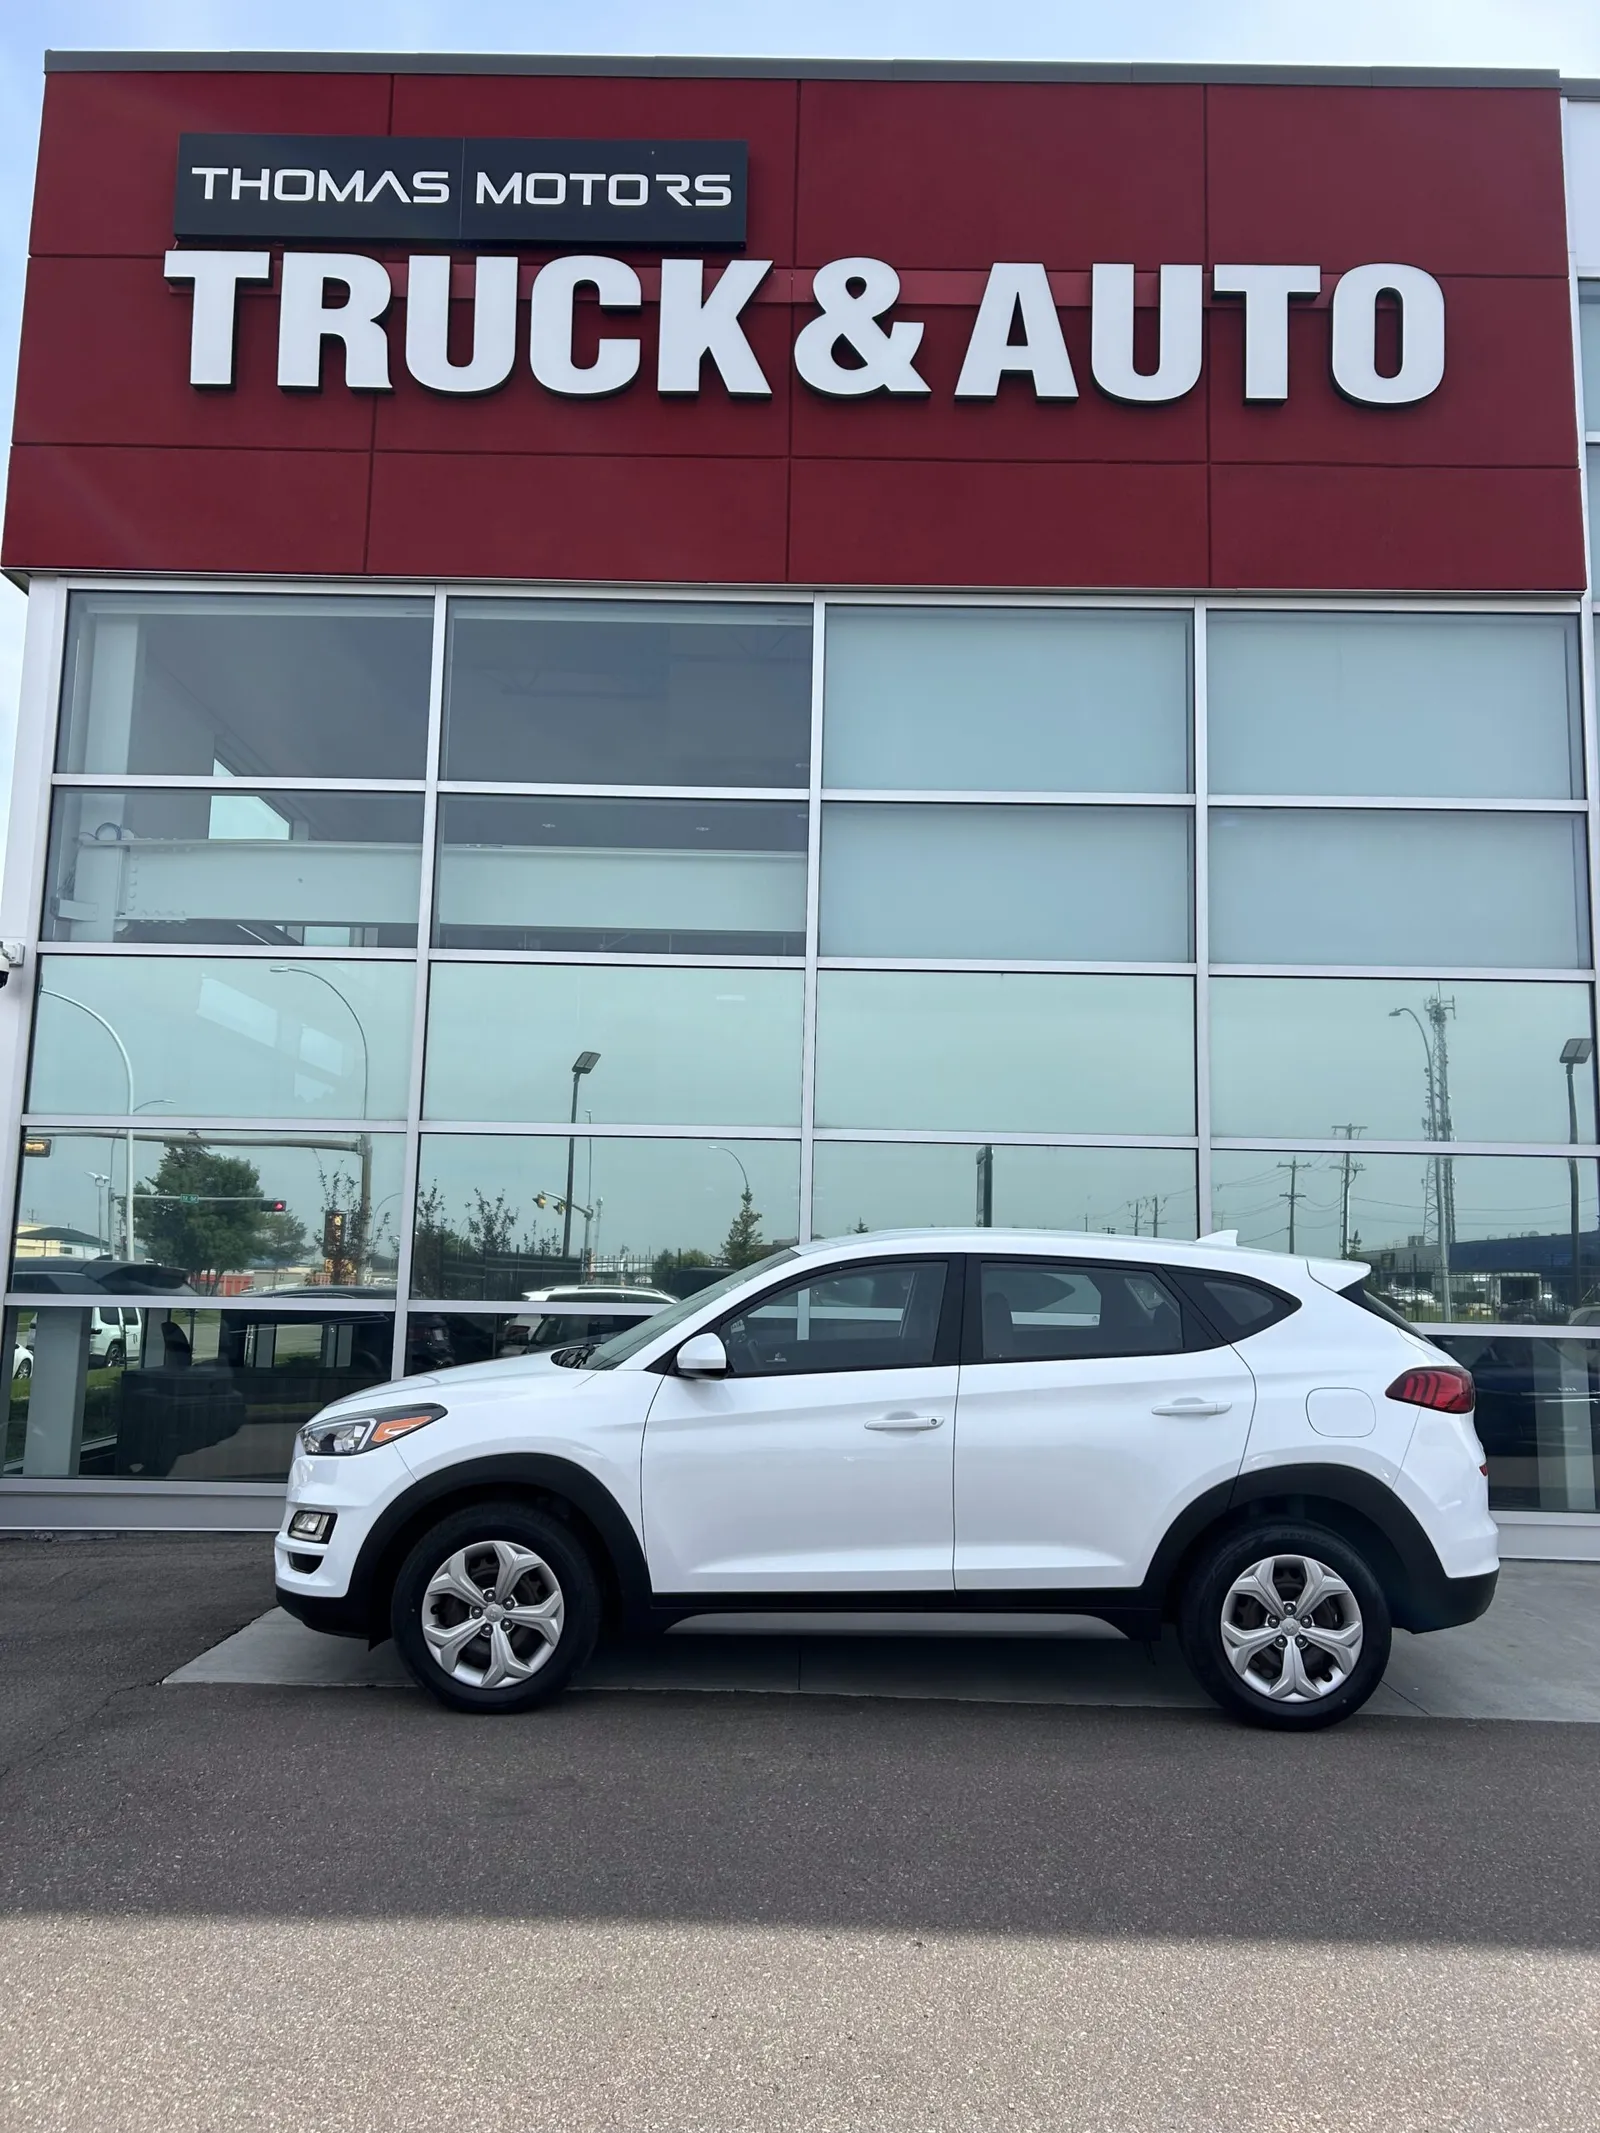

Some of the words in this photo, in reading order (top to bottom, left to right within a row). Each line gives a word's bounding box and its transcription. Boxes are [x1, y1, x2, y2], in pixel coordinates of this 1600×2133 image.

[192, 168, 449, 203] THOMAS
[476, 172, 731, 206] MOTORS
[164, 251, 773, 397] TRUCK
[794, 258, 931, 397] &
[955, 263, 1444, 406] AUTO
